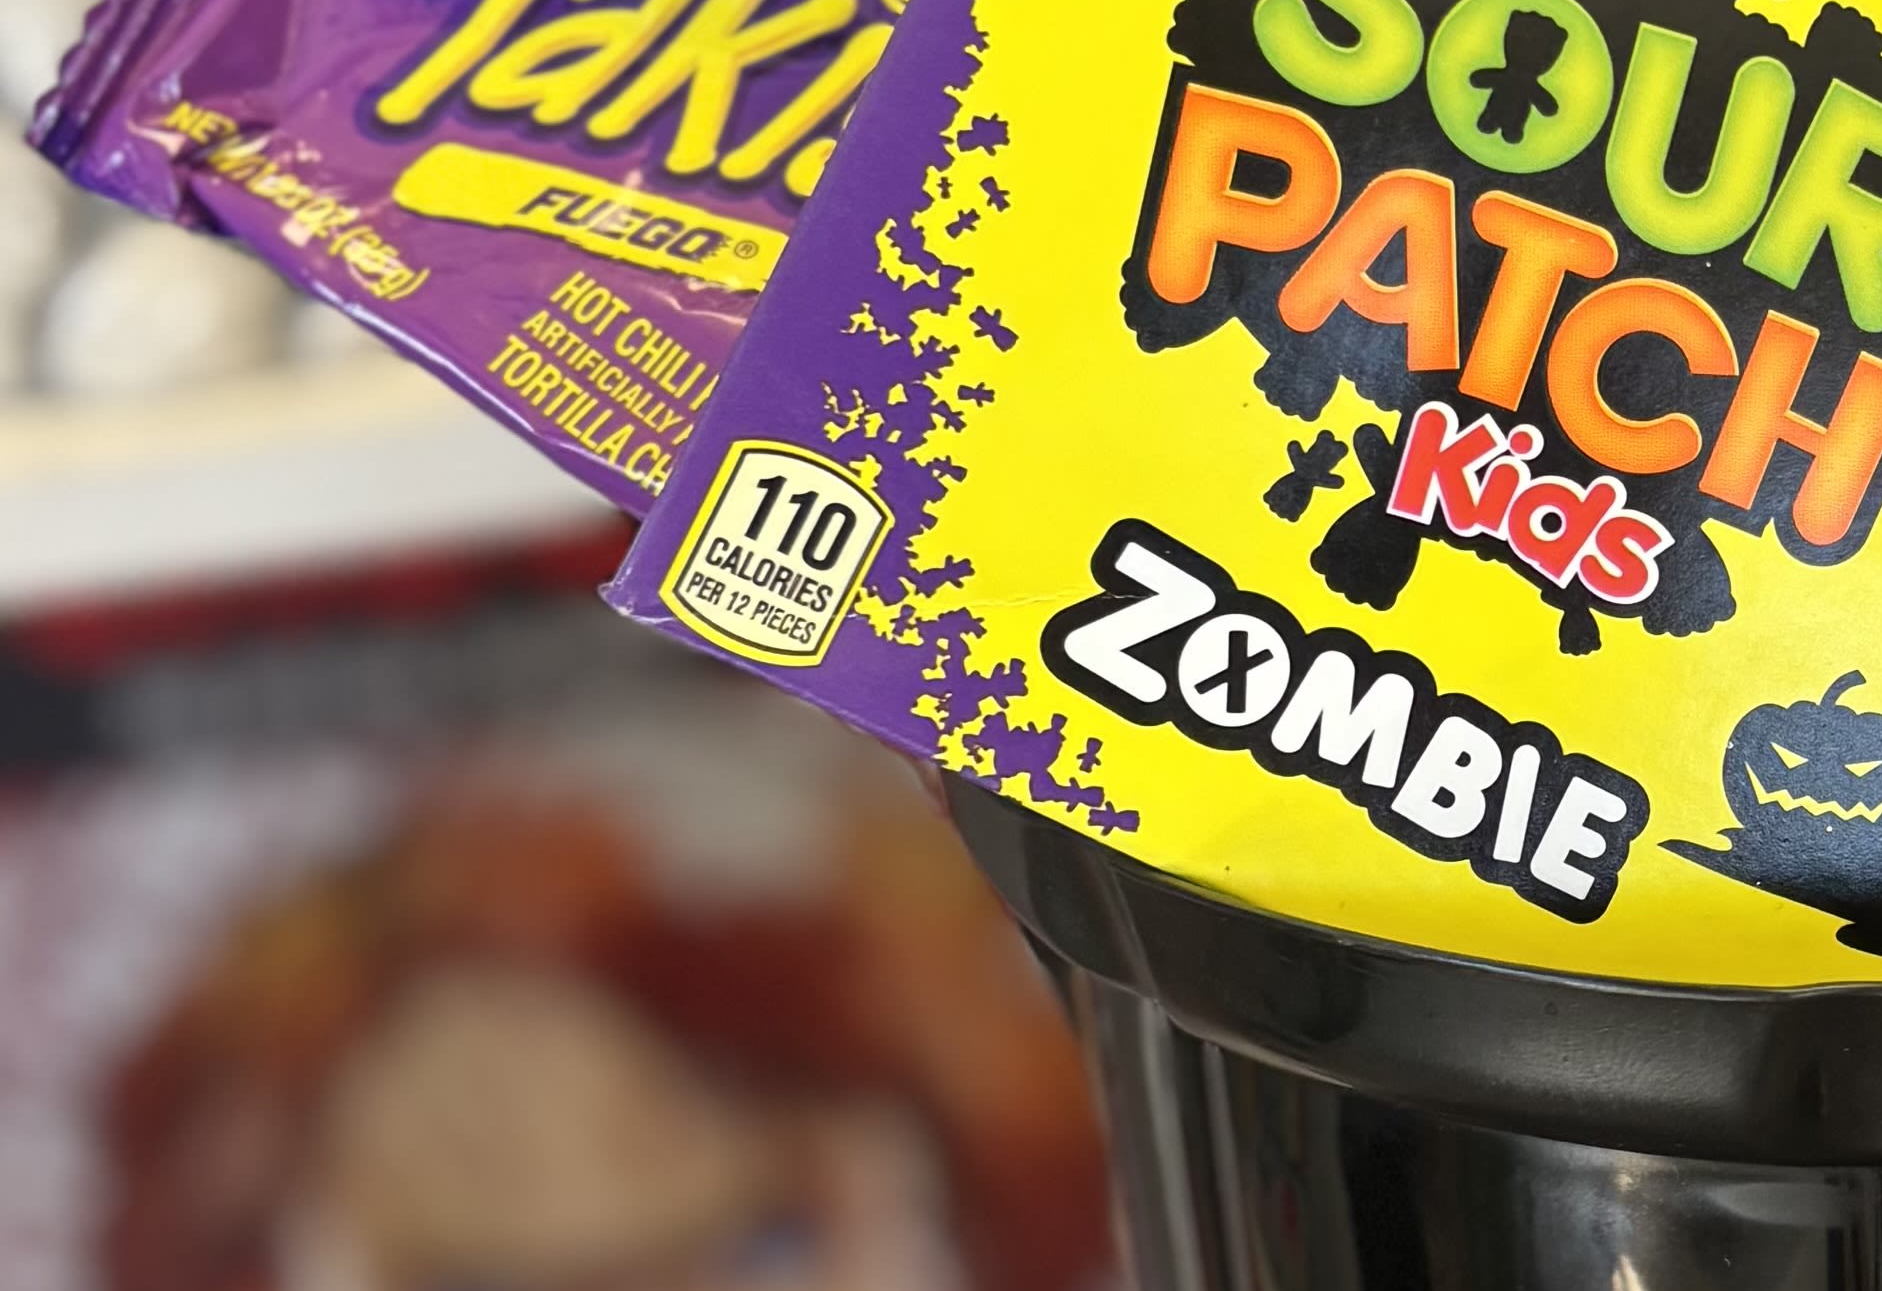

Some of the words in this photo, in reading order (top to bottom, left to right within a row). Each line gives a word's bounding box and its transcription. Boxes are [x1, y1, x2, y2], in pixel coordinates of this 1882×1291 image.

[520, 309, 685, 434] ARTIFICIALLY
[549, 270, 632, 337] HOT
[613, 317, 707, 400] CHILI
[486, 334, 636, 466] TORTILLA
[744, 474, 858, 571] 110
[1390, 402, 1673, 605] Kids
[685, 570, 726, 607] PER
[725, 590, 753, 617] 12
[749, 600, 817, 645] PIECES
[704, 536, 834, 613] CALORIES
[1063, 539, 1628, 901] ZOMBIE
